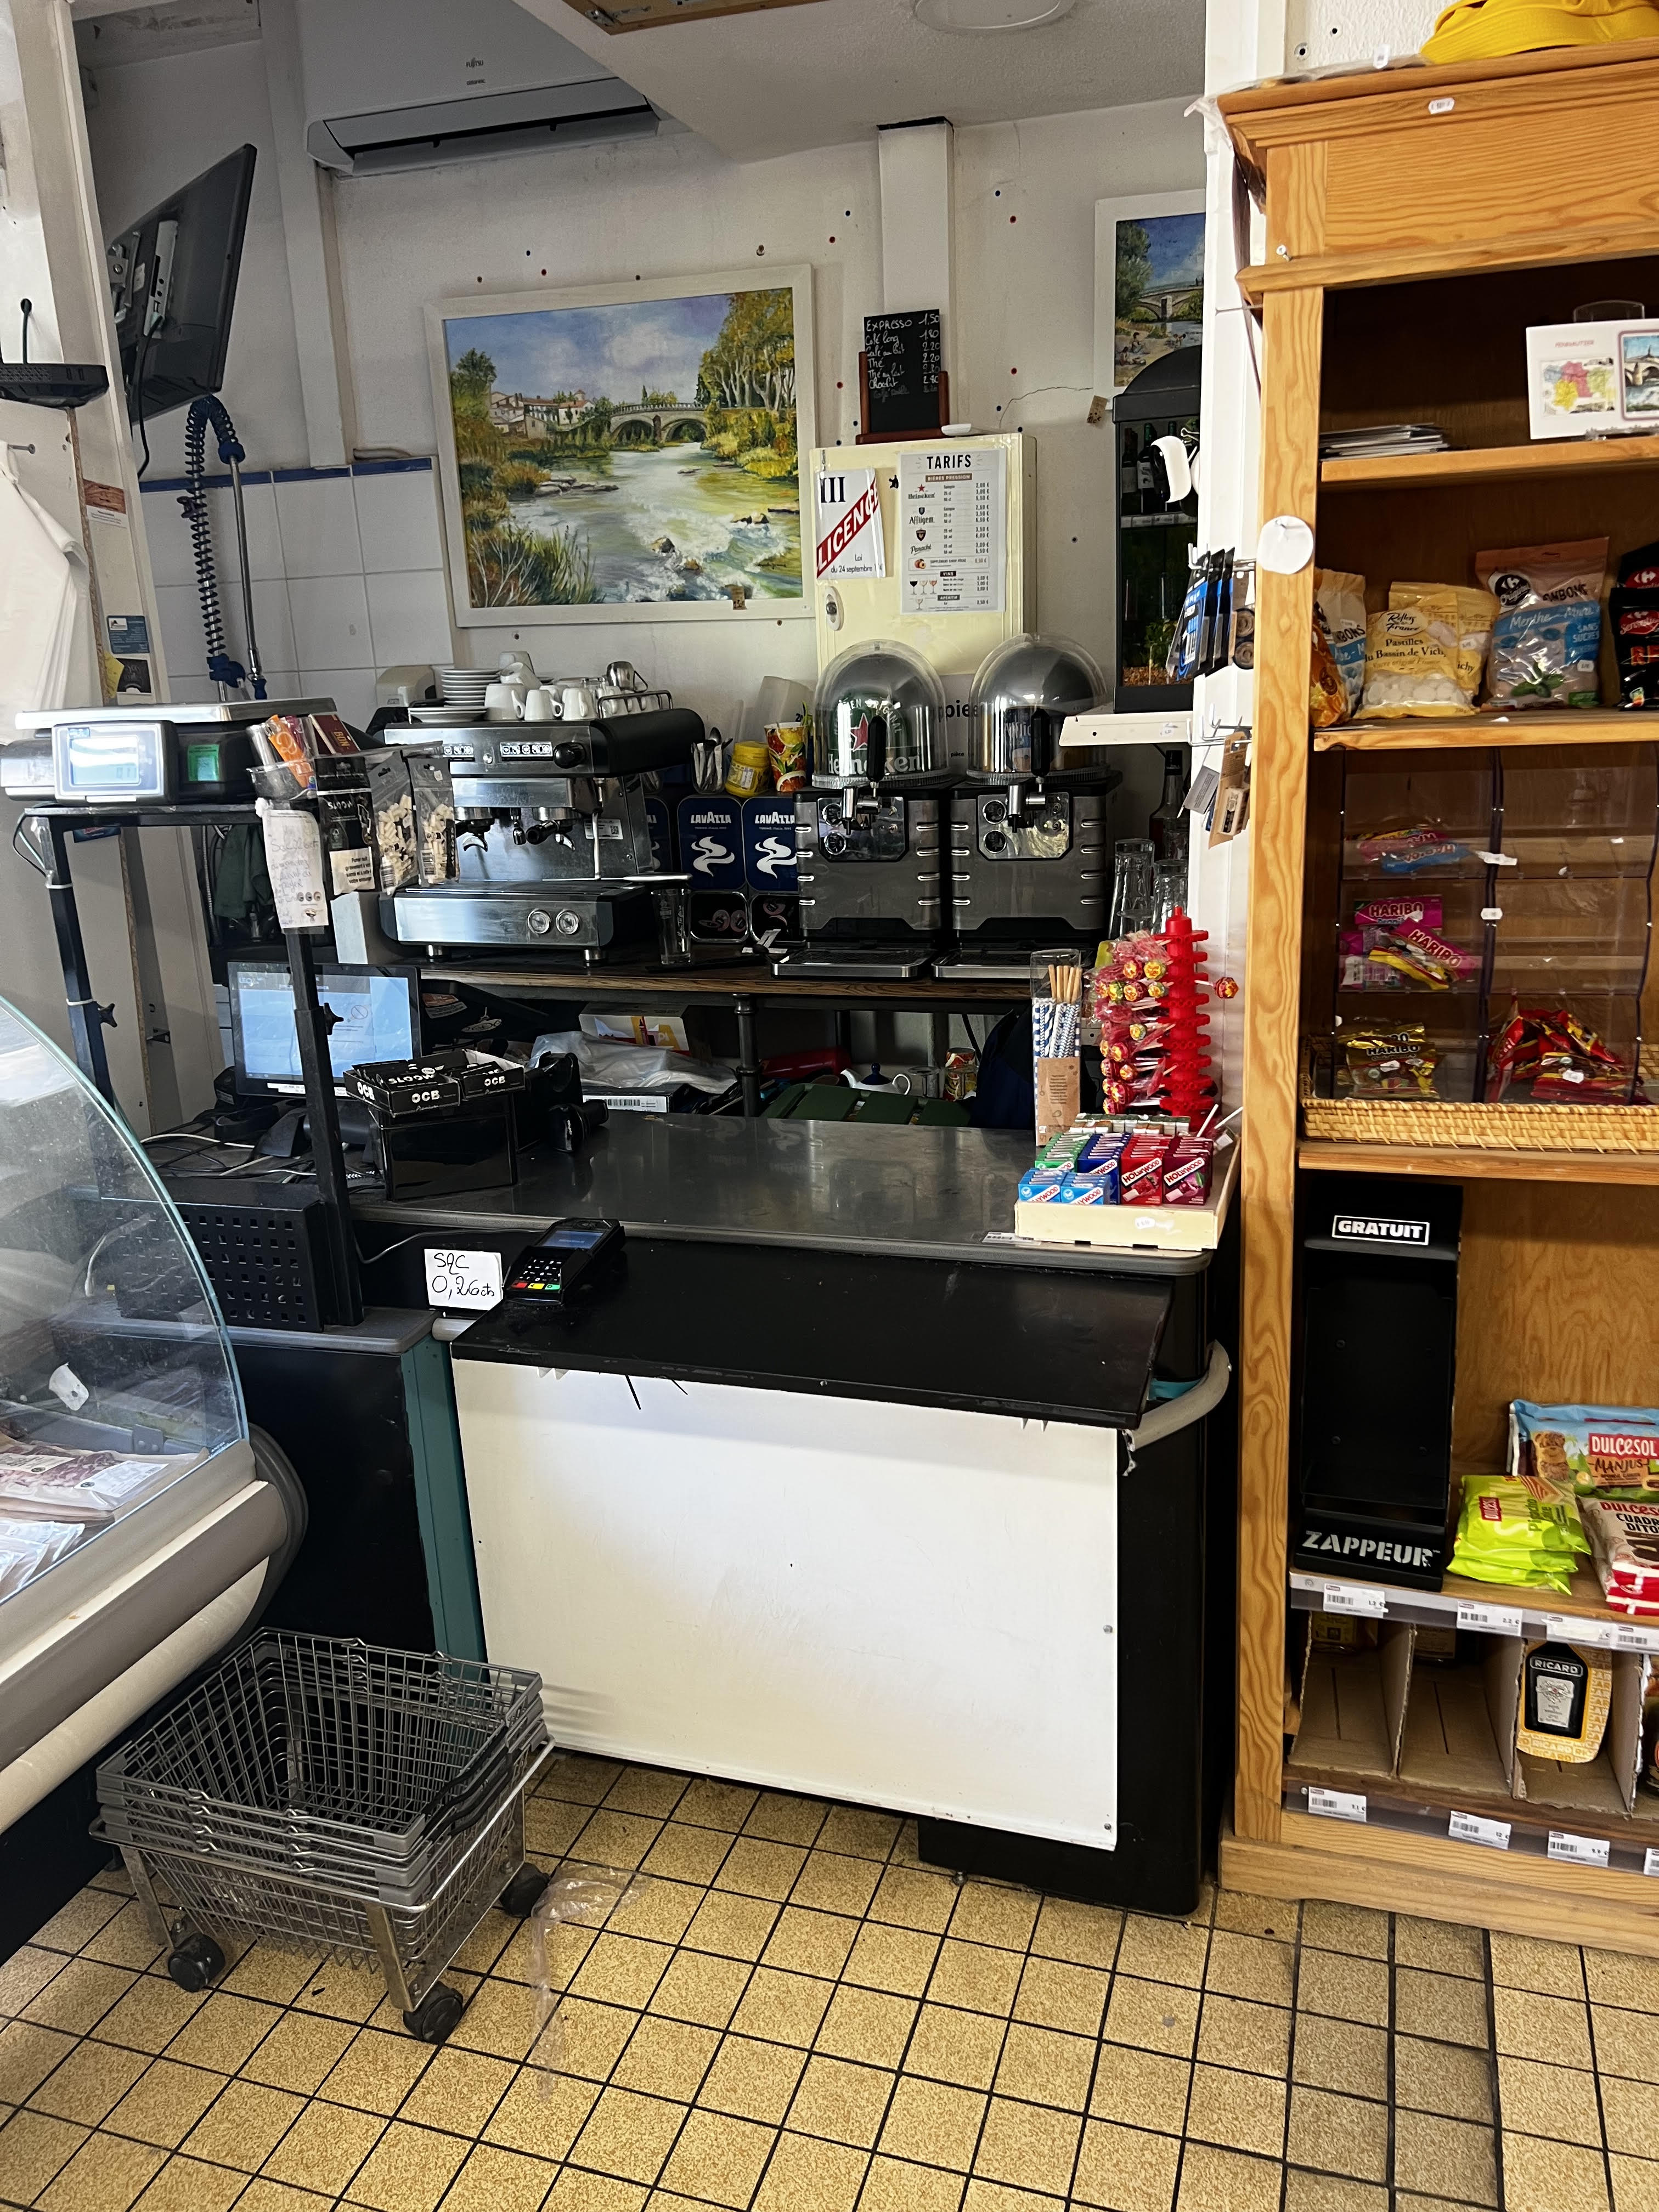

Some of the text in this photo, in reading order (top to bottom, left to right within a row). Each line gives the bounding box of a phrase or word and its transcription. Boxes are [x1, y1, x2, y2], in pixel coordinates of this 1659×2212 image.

[868, 357, 885, 368] Thé
[868, 368, 883, 378] Thé
[927, 455, 971, 469] TARIFS
[820, 476, 845, 503] III
[909, 516, 934, 524] Affligem
[846, 565, 872, 574] septembre
[1386, 623, 1420, 632] France
[1386, 639, 1424, 647] Pastilles
[1376, 650, 1405, 658] Bassin
[1457, 662, 1475, 674] ichy
[691, 812, 732, 824] LAVAZZA
[755, 812, 795, 824] LAVAZZA
[1369, 902, 1424, 917] HARIBO
[1408, 929, 1463, 968] HARIBO
[1367, 1045, 1420, 1056] HARIBO
[484, 1076, 505, 1086] OCB
[357, 1081, 375, 1101] OCB
[411, 1090, 440, 1103] OCB
[1123, 1159, 1160, 1183] HOLLYWOOD
[1165, 1159, 1203, 1183] HOLLYWOOD
[1338, 1220, 1423, 1238] GRATUIT
[434, 1252, 469, 1274] SAC
[1595, 1458, 1644, 1474] MANJUS
[1534, 1660, 1578, 1673] RICARD
